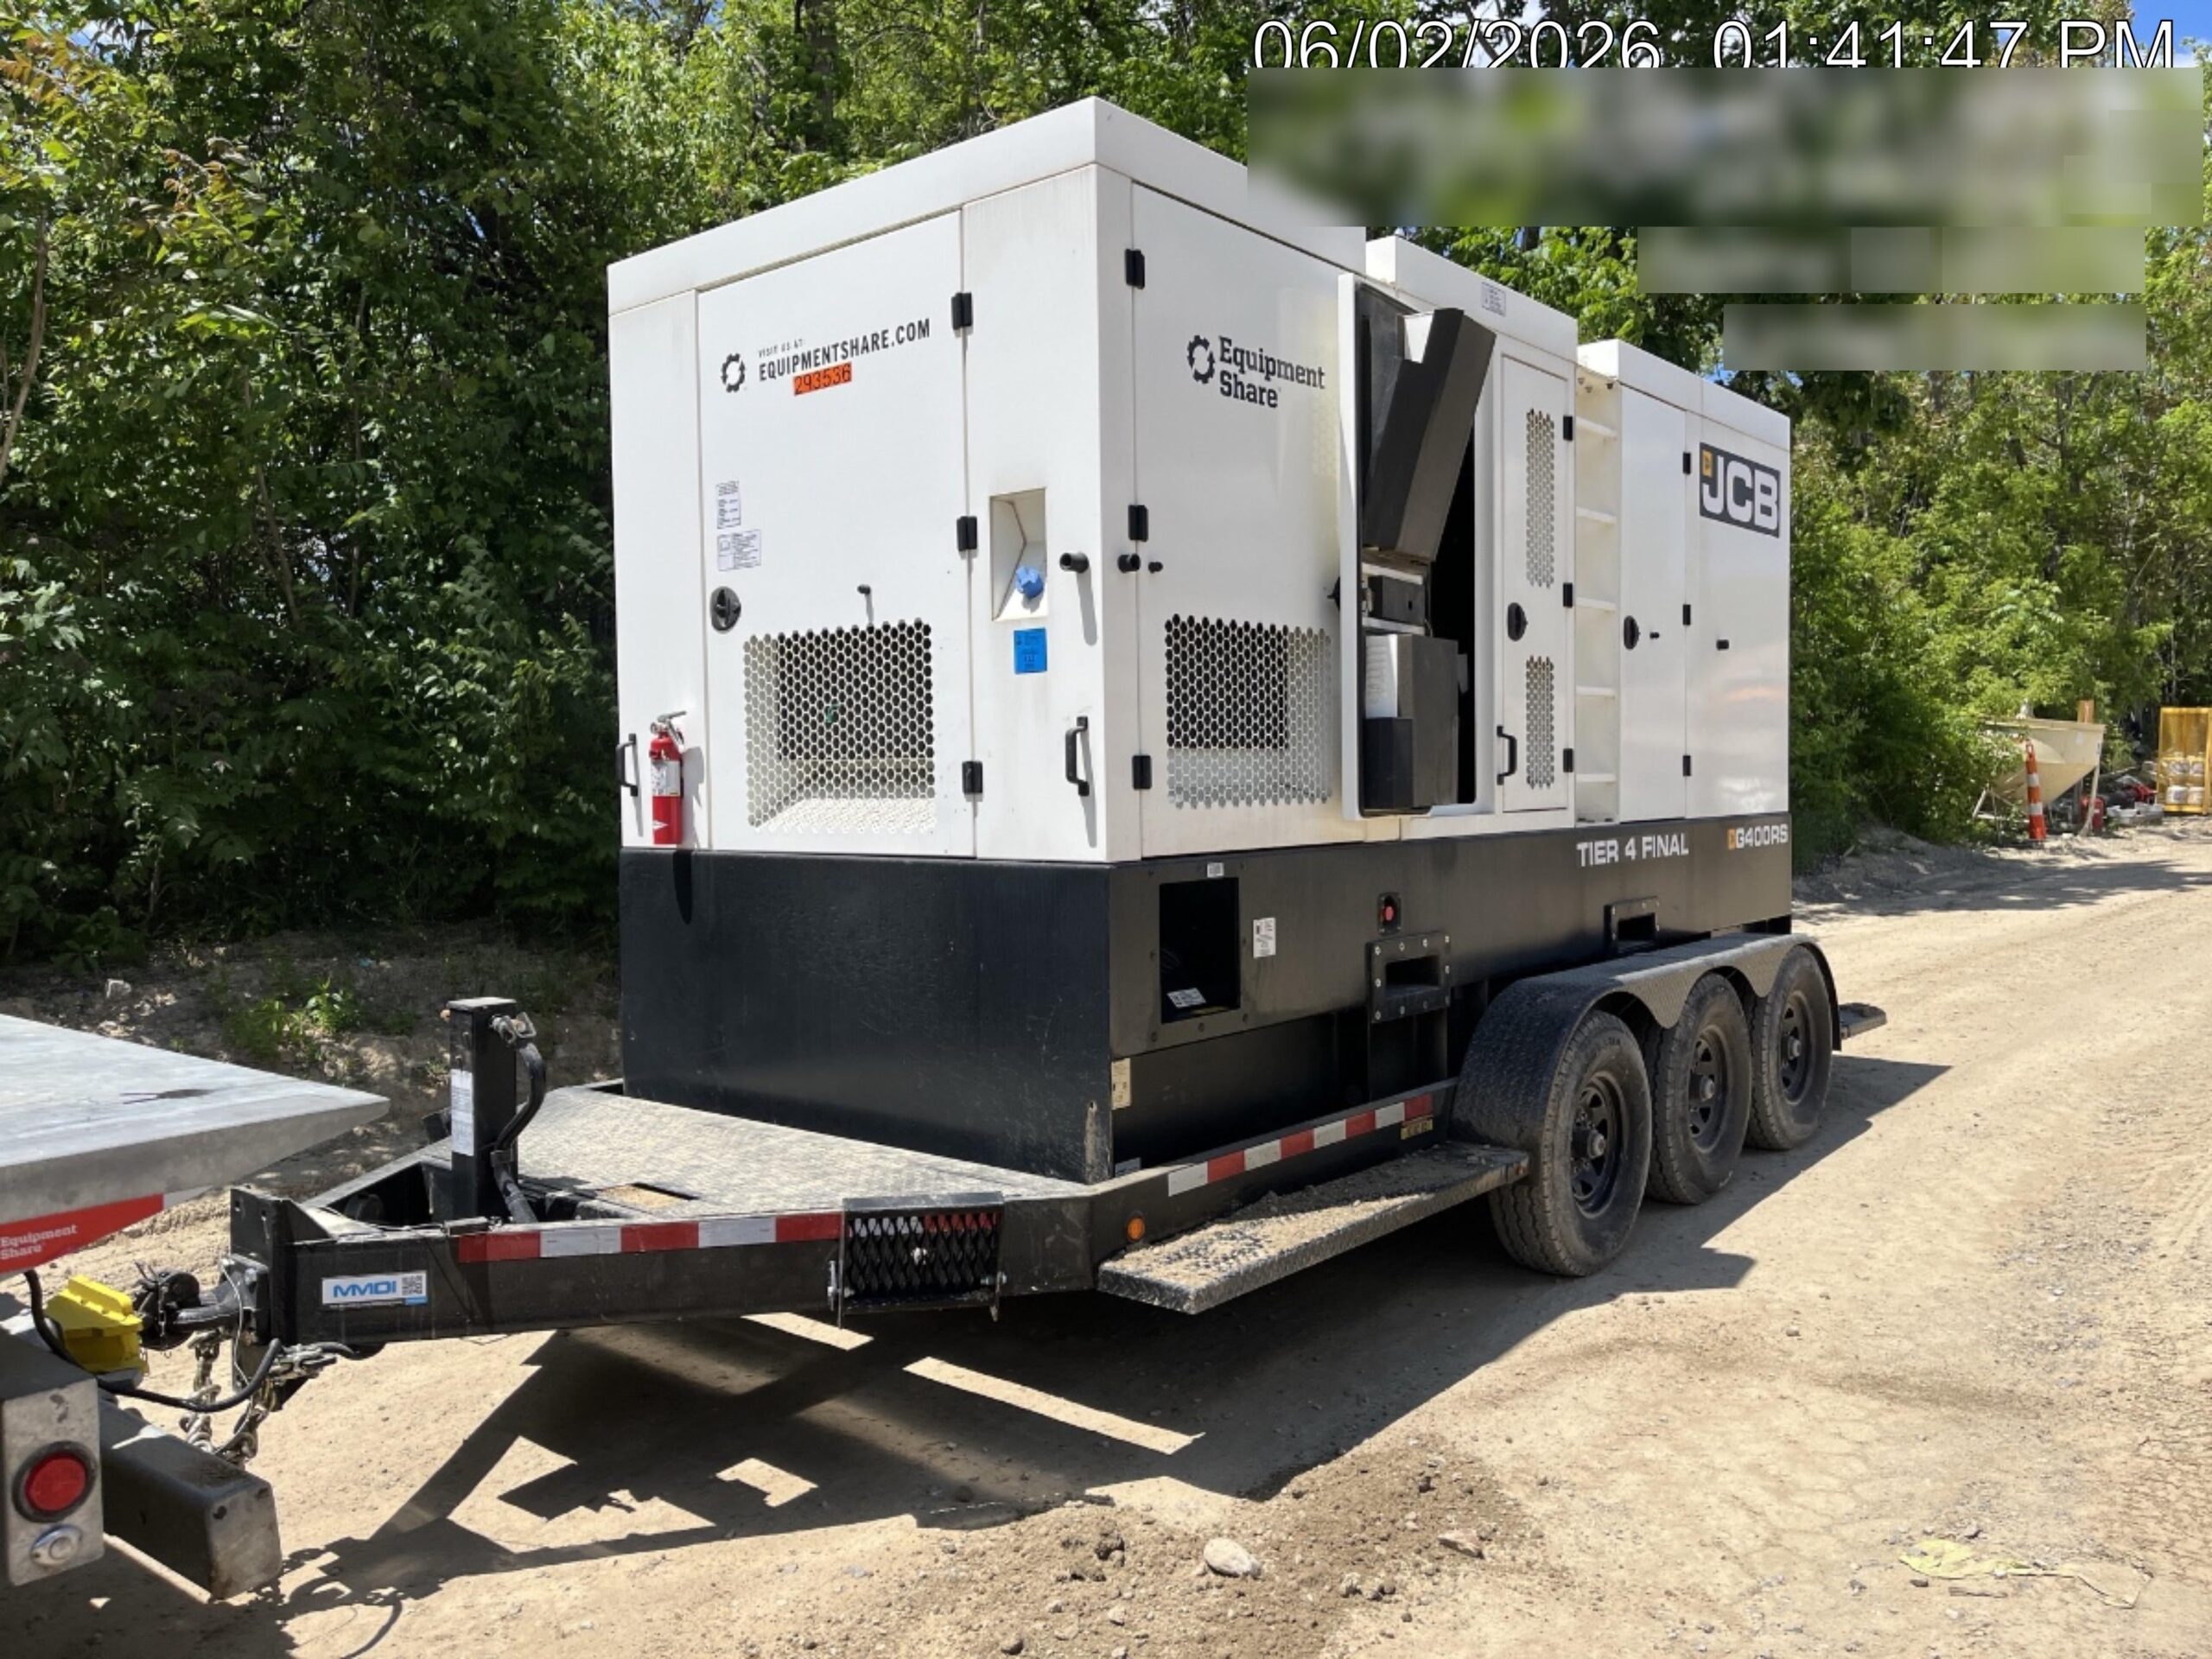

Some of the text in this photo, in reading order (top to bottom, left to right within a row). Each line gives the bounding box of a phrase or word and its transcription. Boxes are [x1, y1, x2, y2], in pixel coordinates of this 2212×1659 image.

[759, 317, 931, 382] EQUIPMENTSHARE.COM
[1218, 335, 1325, 390] Equipment
[793, 362, 852, 396] 293536
[1219, 370, 1279, 409] Share
[1702, 454, 1778, 531] JCB
[1575, 832, 1689, 868] TIER 4 FINAL
[1736, 823, 1789, 849] G400RS
[1, 1224, 78, 1248] Equipment
[1, 1244, 43, 1260] Share
